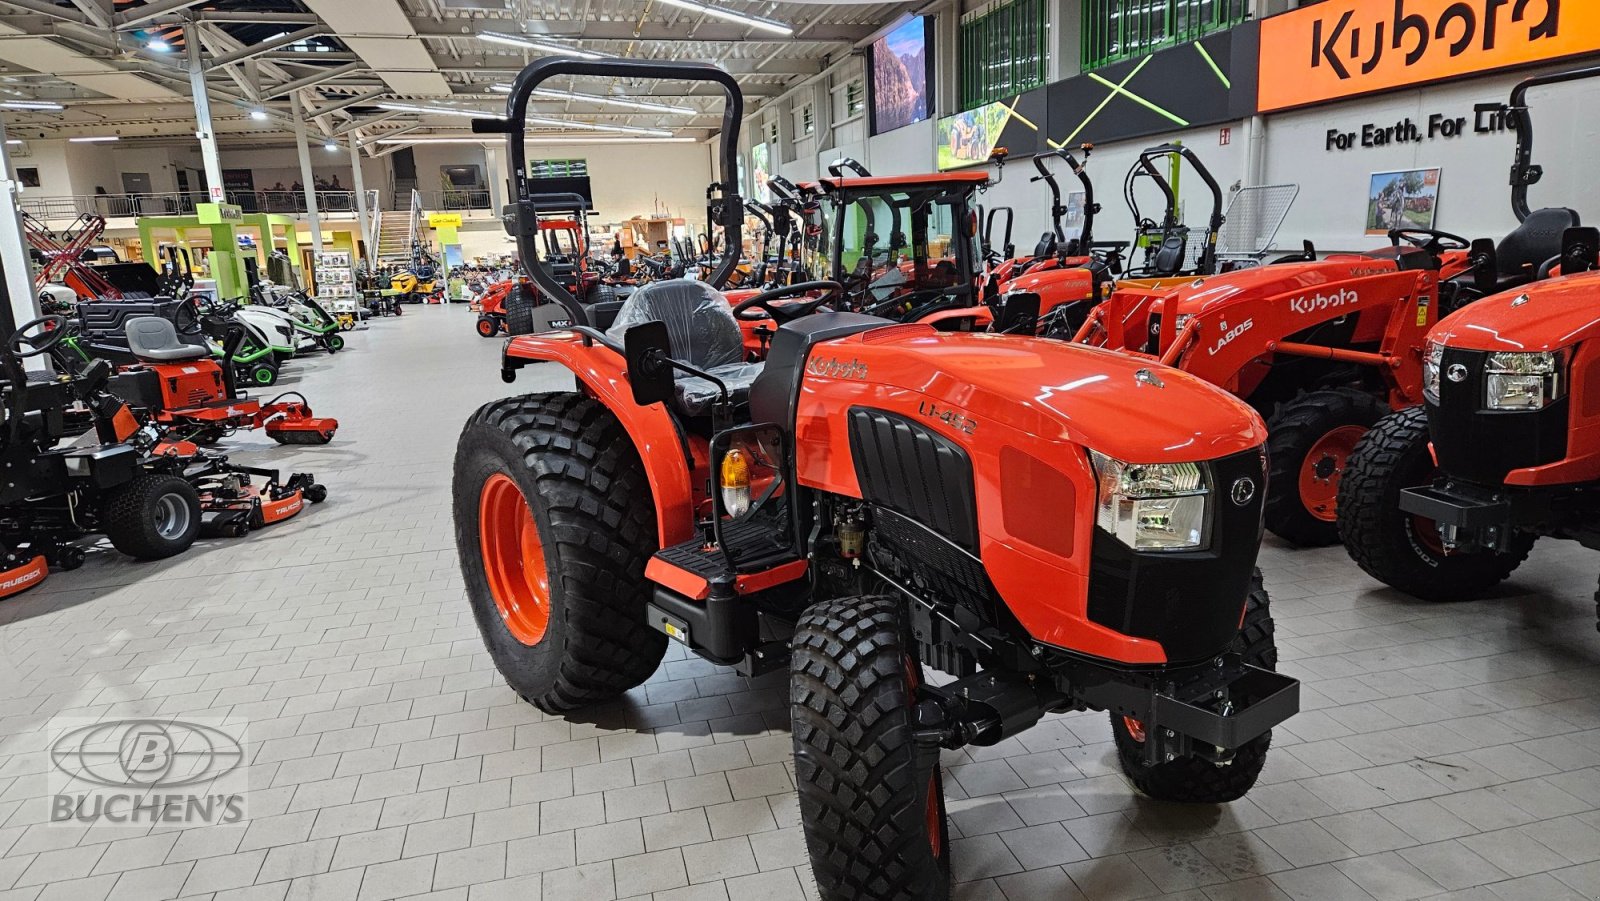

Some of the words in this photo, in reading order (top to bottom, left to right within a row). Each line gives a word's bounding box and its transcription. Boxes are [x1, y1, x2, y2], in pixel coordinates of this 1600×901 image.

[1311, 0, 1562, 80] Kubota
[1326, 128, 1356, 151] For
[1361, 117, 1422, 148] Earth,
[1428, 113, 1466, 139] For
[1290, 287, 1358, 314] Kubota
[1208, 317, 1254, 357] LA805
[807, 355, 868, 380] Kubota
